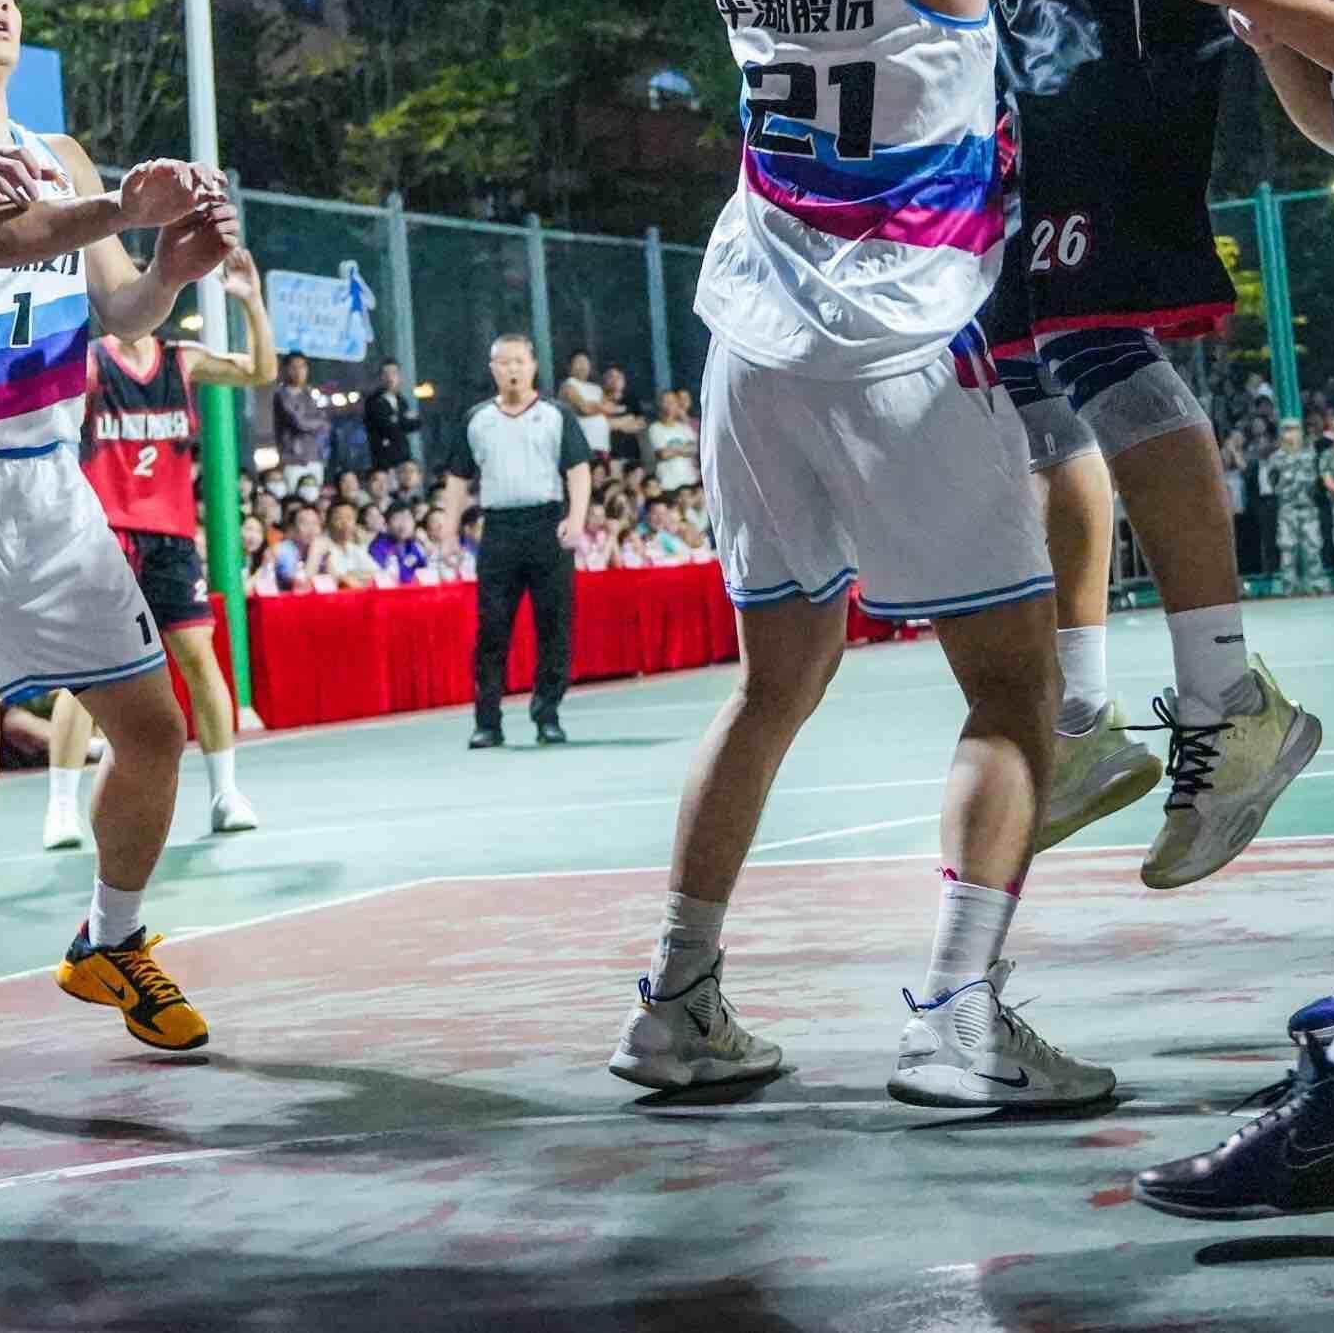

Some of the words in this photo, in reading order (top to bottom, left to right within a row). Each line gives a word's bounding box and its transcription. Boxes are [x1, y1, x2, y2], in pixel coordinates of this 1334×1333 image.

[743, 60, 876, 160] 21
[1030, 214, 1088, 272] 26
[11, 291, 34, 348] 1
[132, 445, 158, 479] 2
[193, 577, 209, 603] 2
[135, 610, 153, 646] 1
